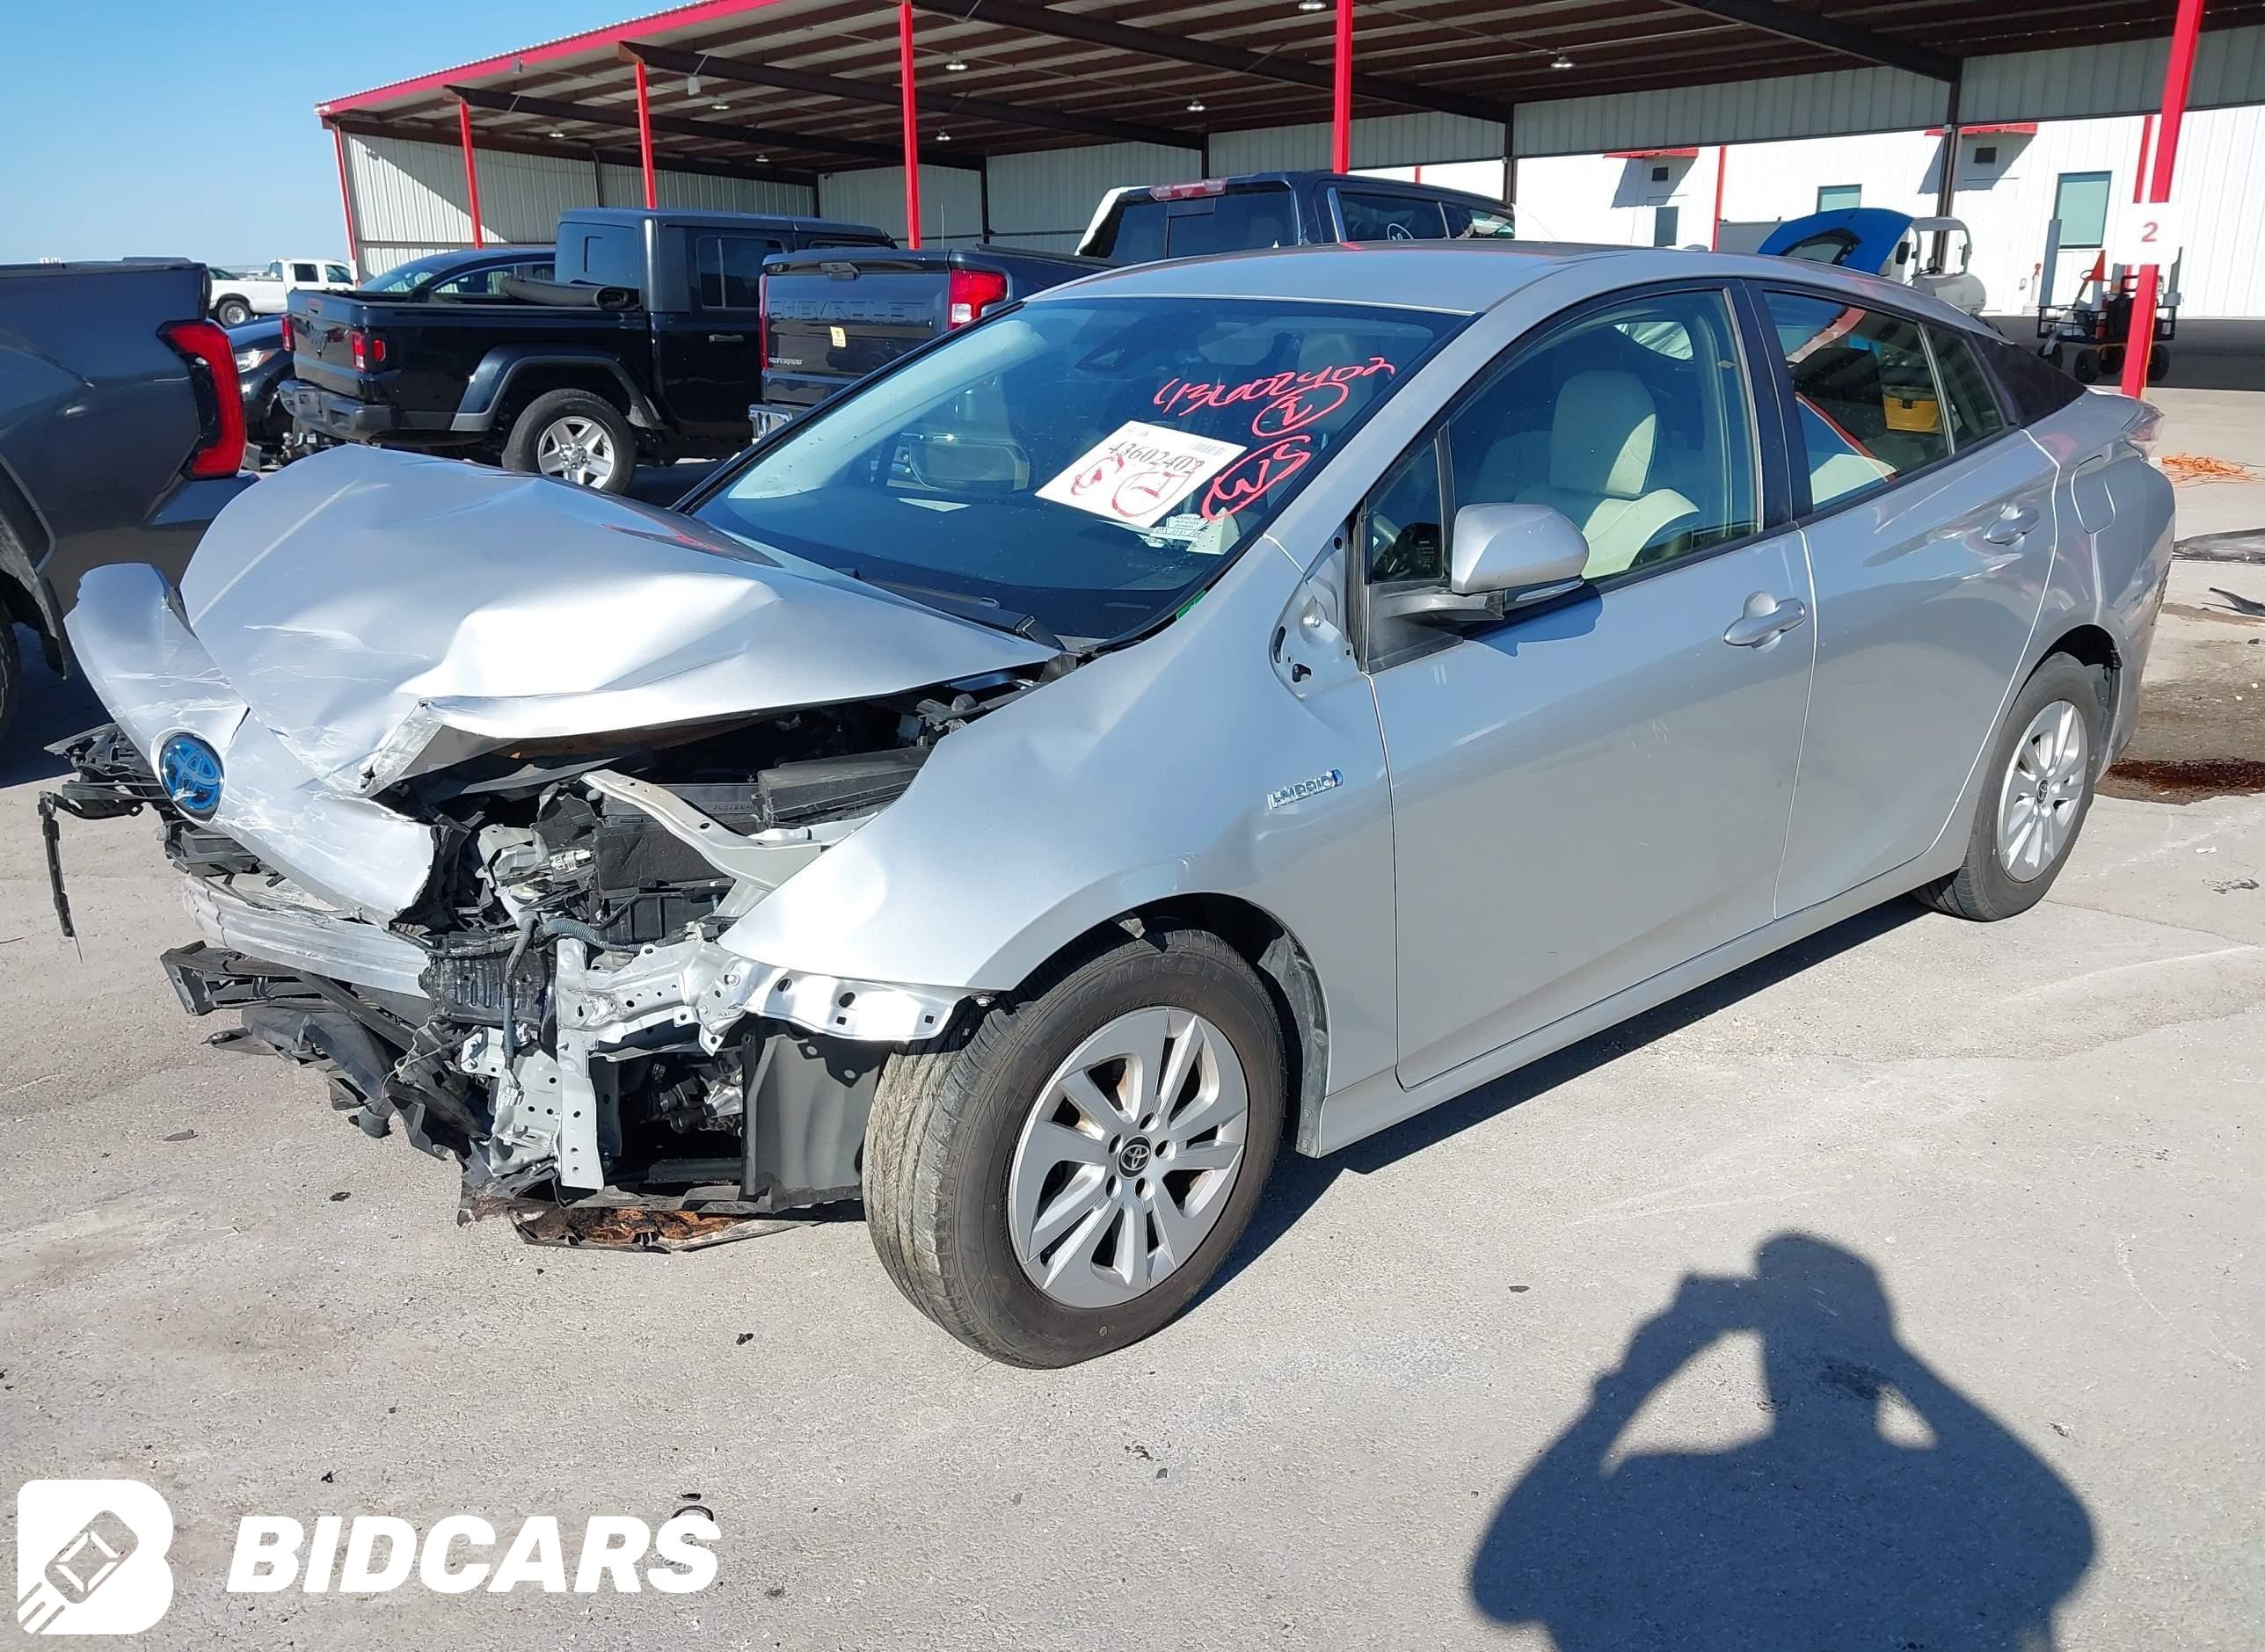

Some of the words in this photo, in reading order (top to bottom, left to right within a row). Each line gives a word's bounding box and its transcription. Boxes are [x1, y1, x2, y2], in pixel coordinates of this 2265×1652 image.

[2141, 222, 2159, 243] 2
[1108, 440, 1205, 475] 43602402
[1267, 768, 1343, 809] HYBRID
